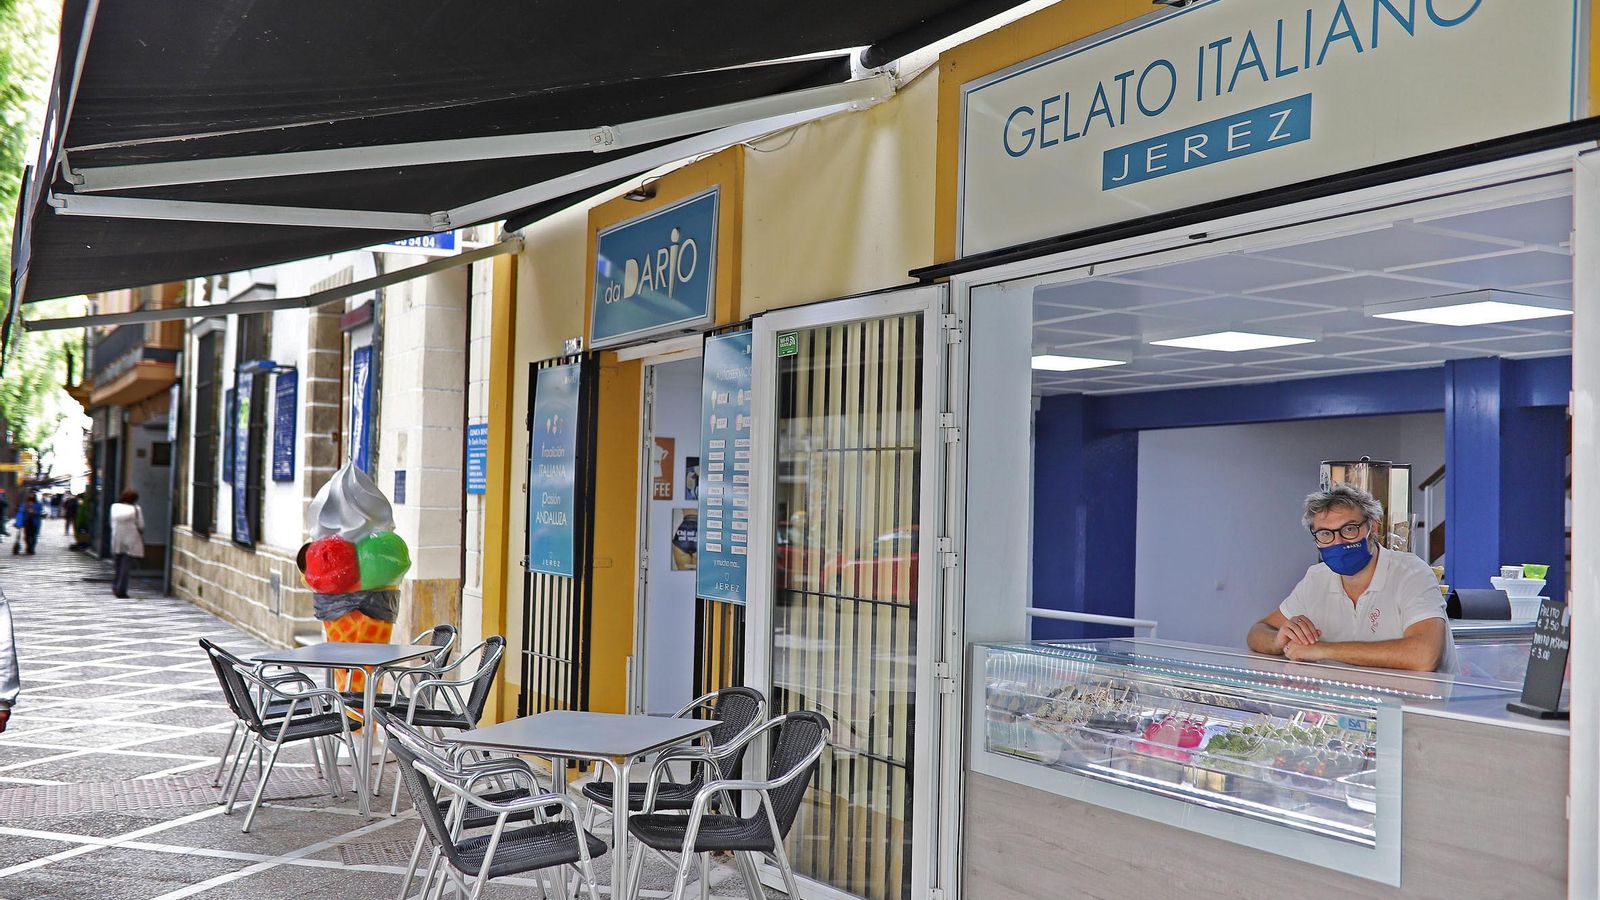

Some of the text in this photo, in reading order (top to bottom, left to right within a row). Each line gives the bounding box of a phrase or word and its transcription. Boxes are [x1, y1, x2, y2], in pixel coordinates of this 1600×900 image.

[1003, 59, 1177, 157] GELATO
[1111, 108, 1293, 182] JEREZ
[604, 280, 621, 304] da
[536, 511, 568, 526] ANDALUZA
[542, 559, 561, 567] JEREZ
[714, 582, 740, 593] JEREZ
[1540, 605, 1560, 619] PALITO
